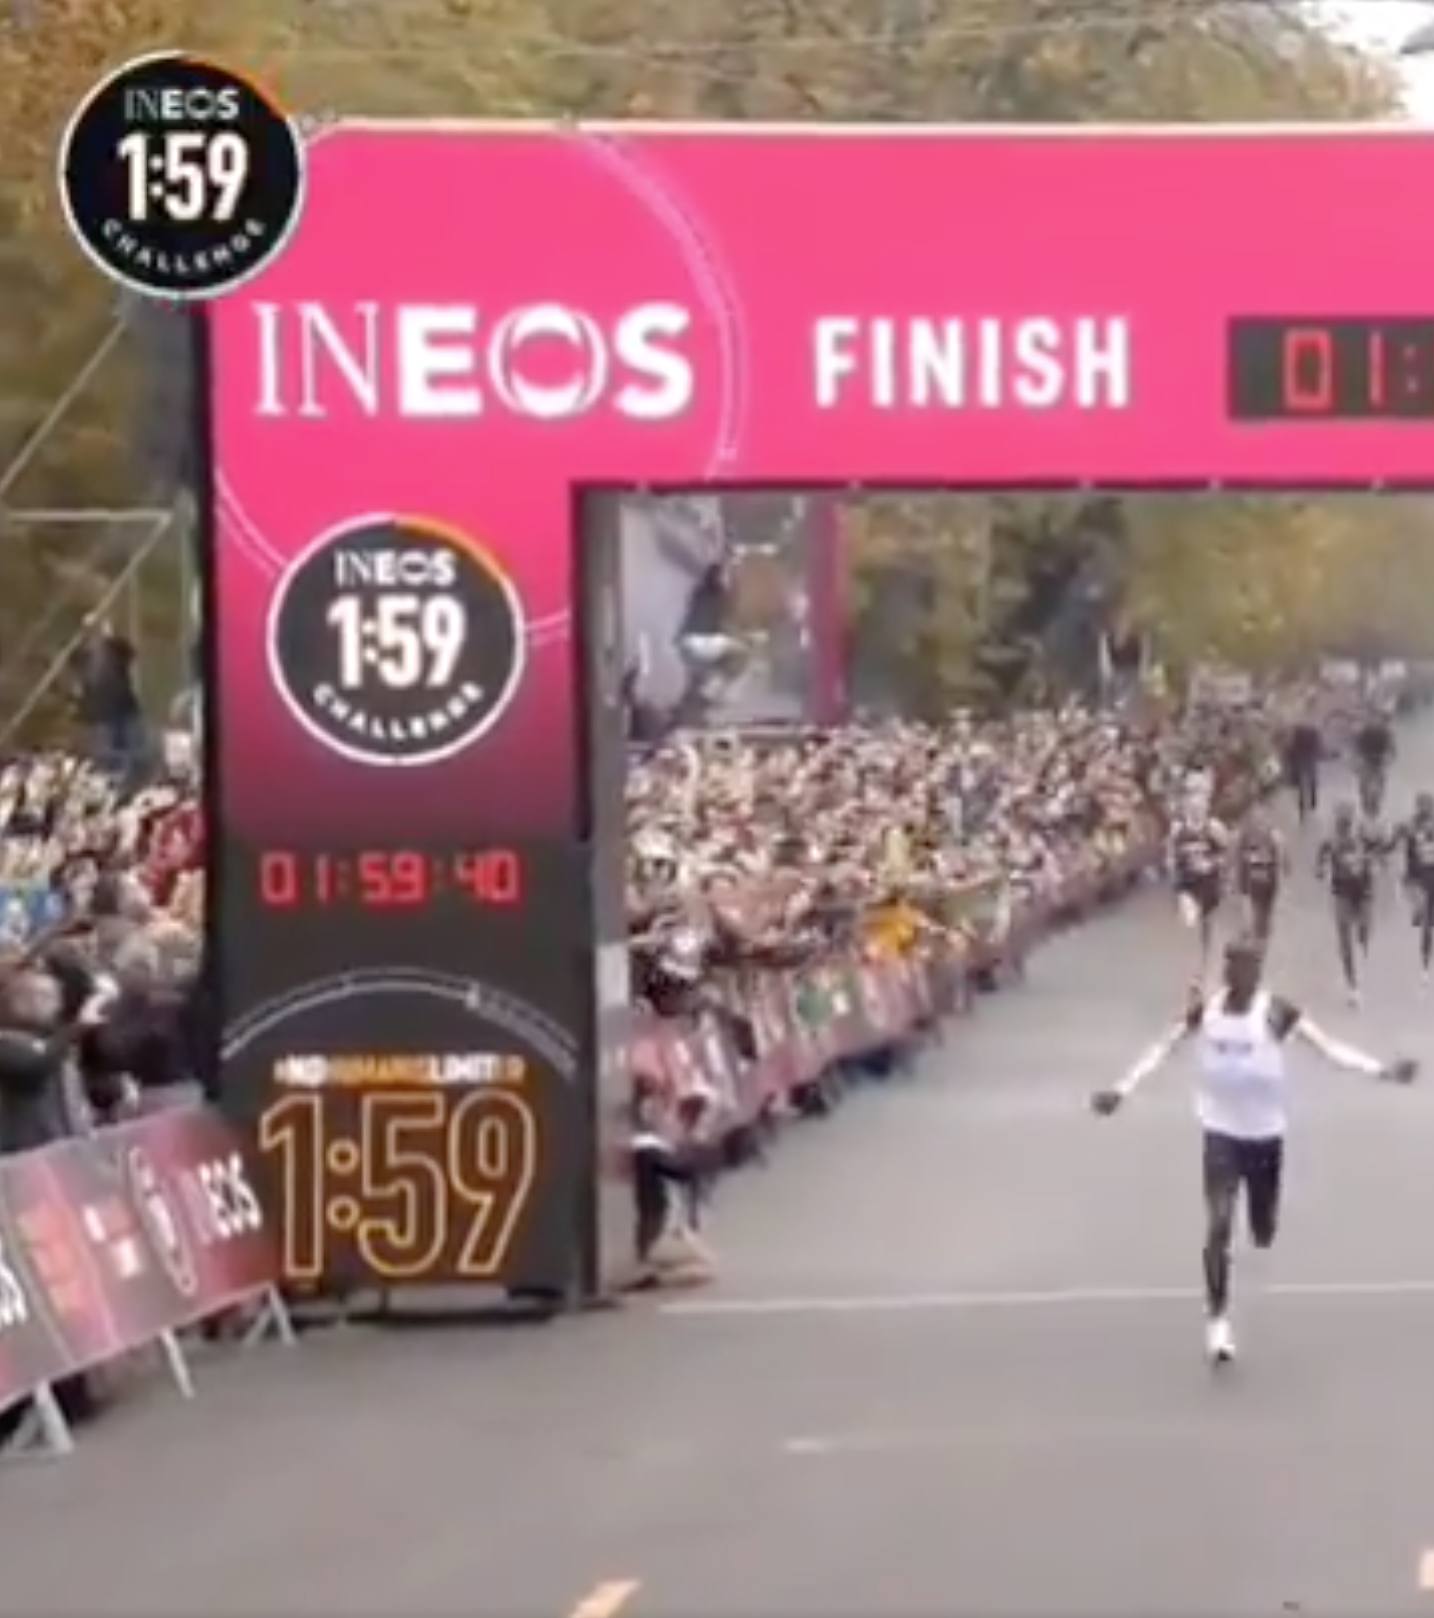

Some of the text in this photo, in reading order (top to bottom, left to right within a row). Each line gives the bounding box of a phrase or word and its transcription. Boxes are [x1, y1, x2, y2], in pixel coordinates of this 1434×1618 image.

[252, 301, 694, 419] INEOS
[812, 315, 1131, 409] FINISH
[333, 548, 458, 588] INEOS
[325, 593, 468, 690] 1:59
[313, 682, 484, 740] CHALLENGE
[260, 851, 520, 904] 01:59:40
[258, 1091, 535, 1279] 1:59
